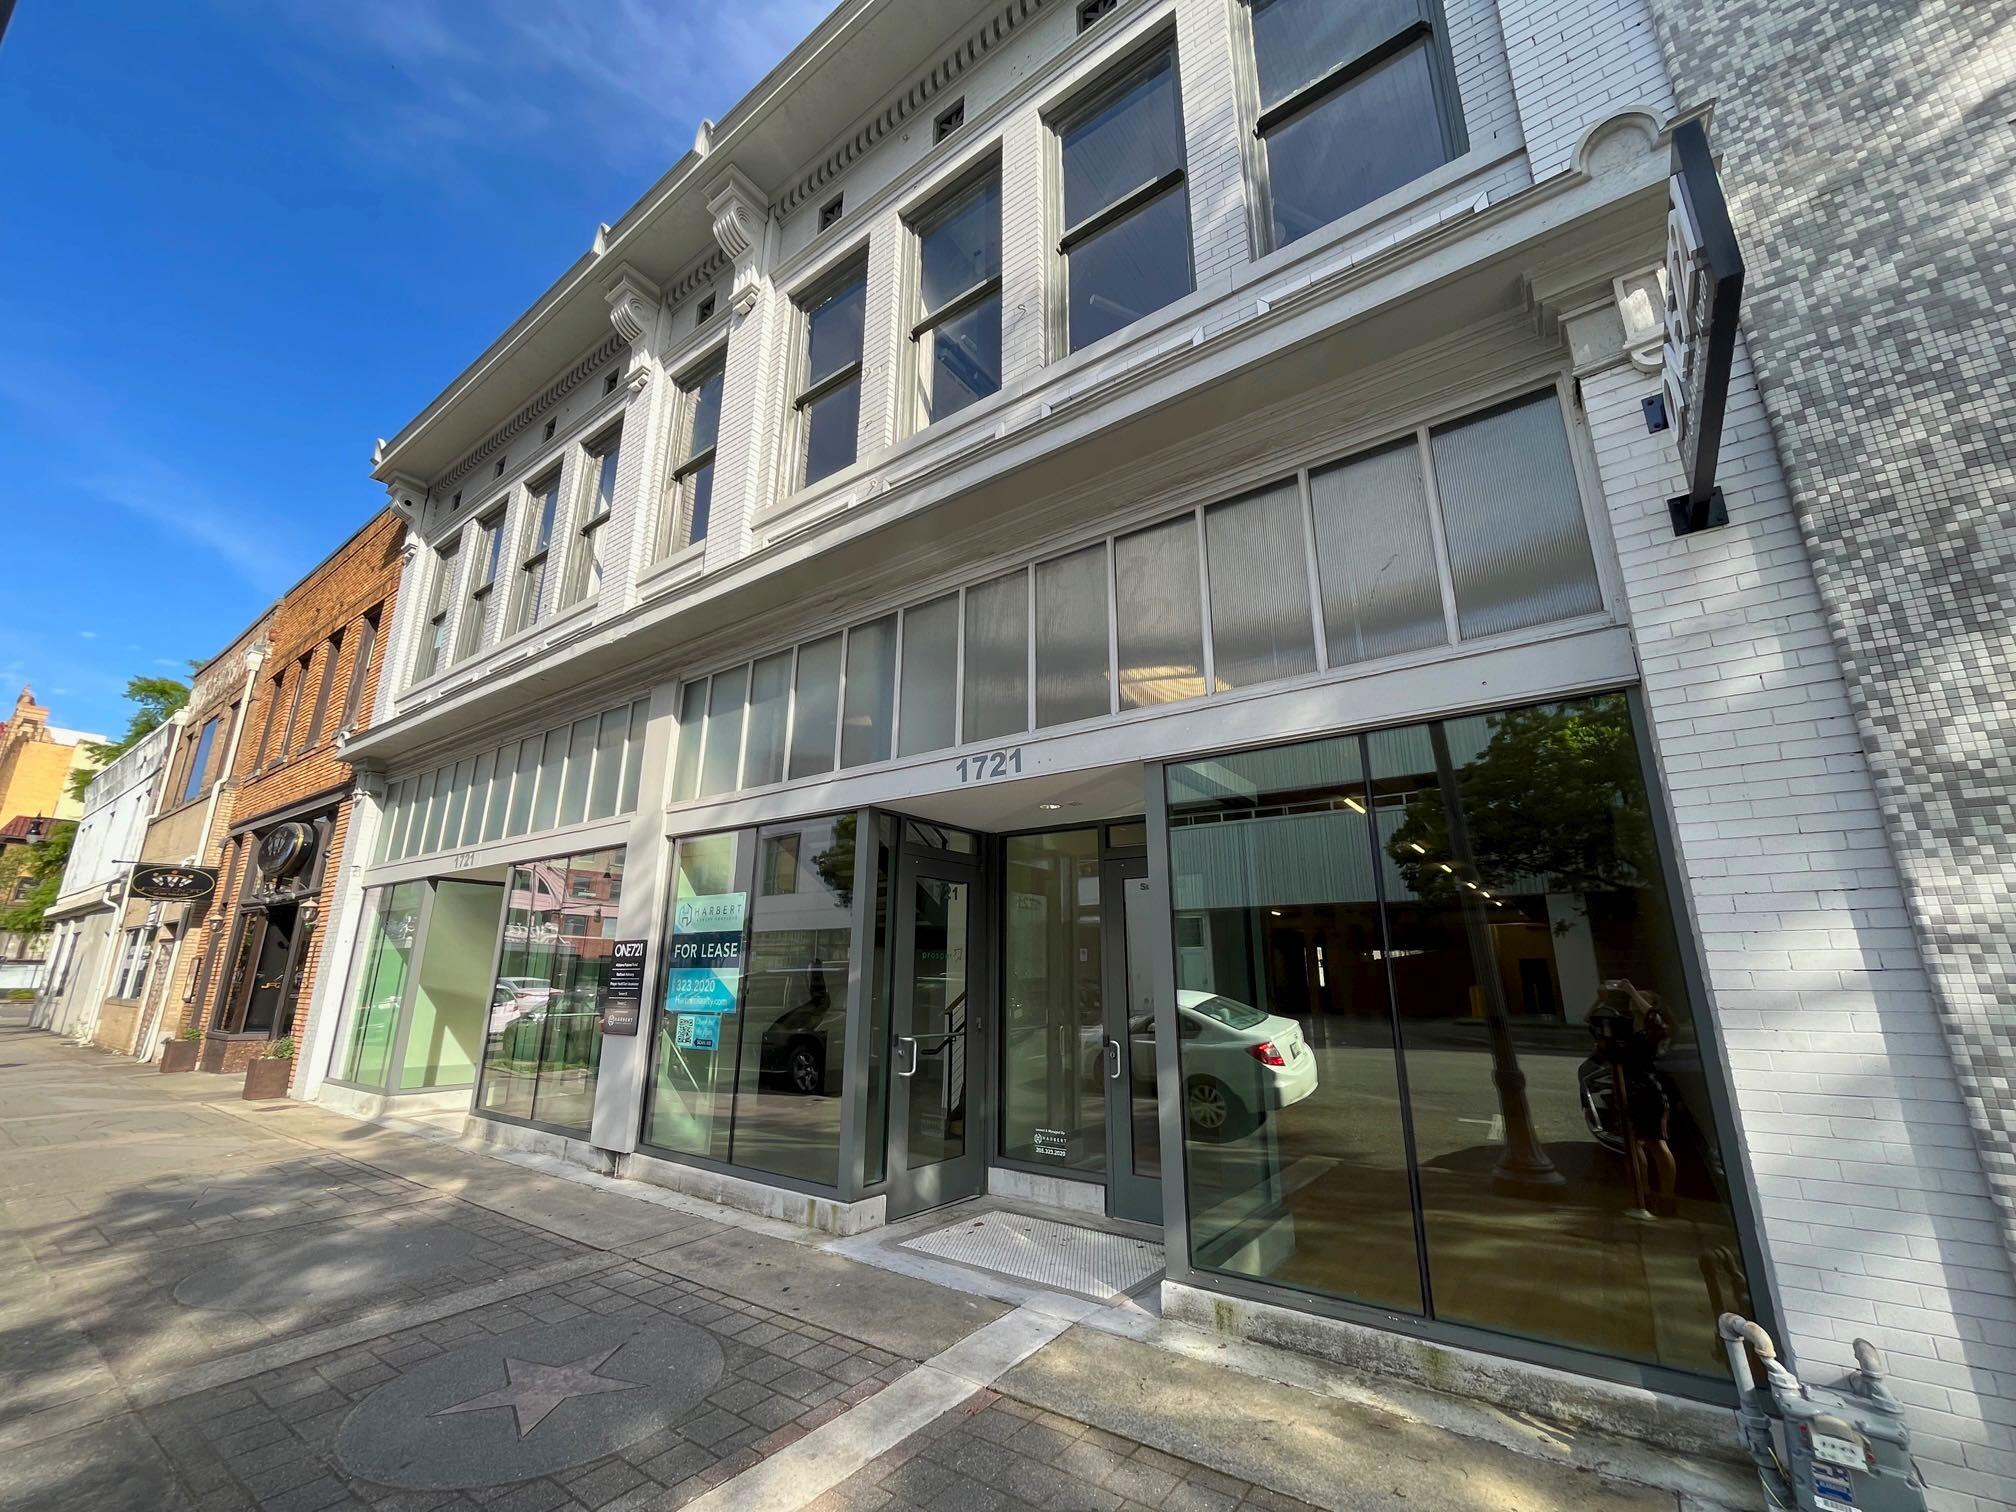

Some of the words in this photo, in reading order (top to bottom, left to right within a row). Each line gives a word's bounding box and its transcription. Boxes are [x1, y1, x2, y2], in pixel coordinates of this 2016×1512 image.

[956, 747, 1022, 783] 1721
[455, 852, 475, 868] 1721
[694, 904, 742, 916] HARBERT
[614, 943, 643, 957] ONE721
[674, 943, 698, 958] FOR
[701, 942, 738, 958] LEASE
